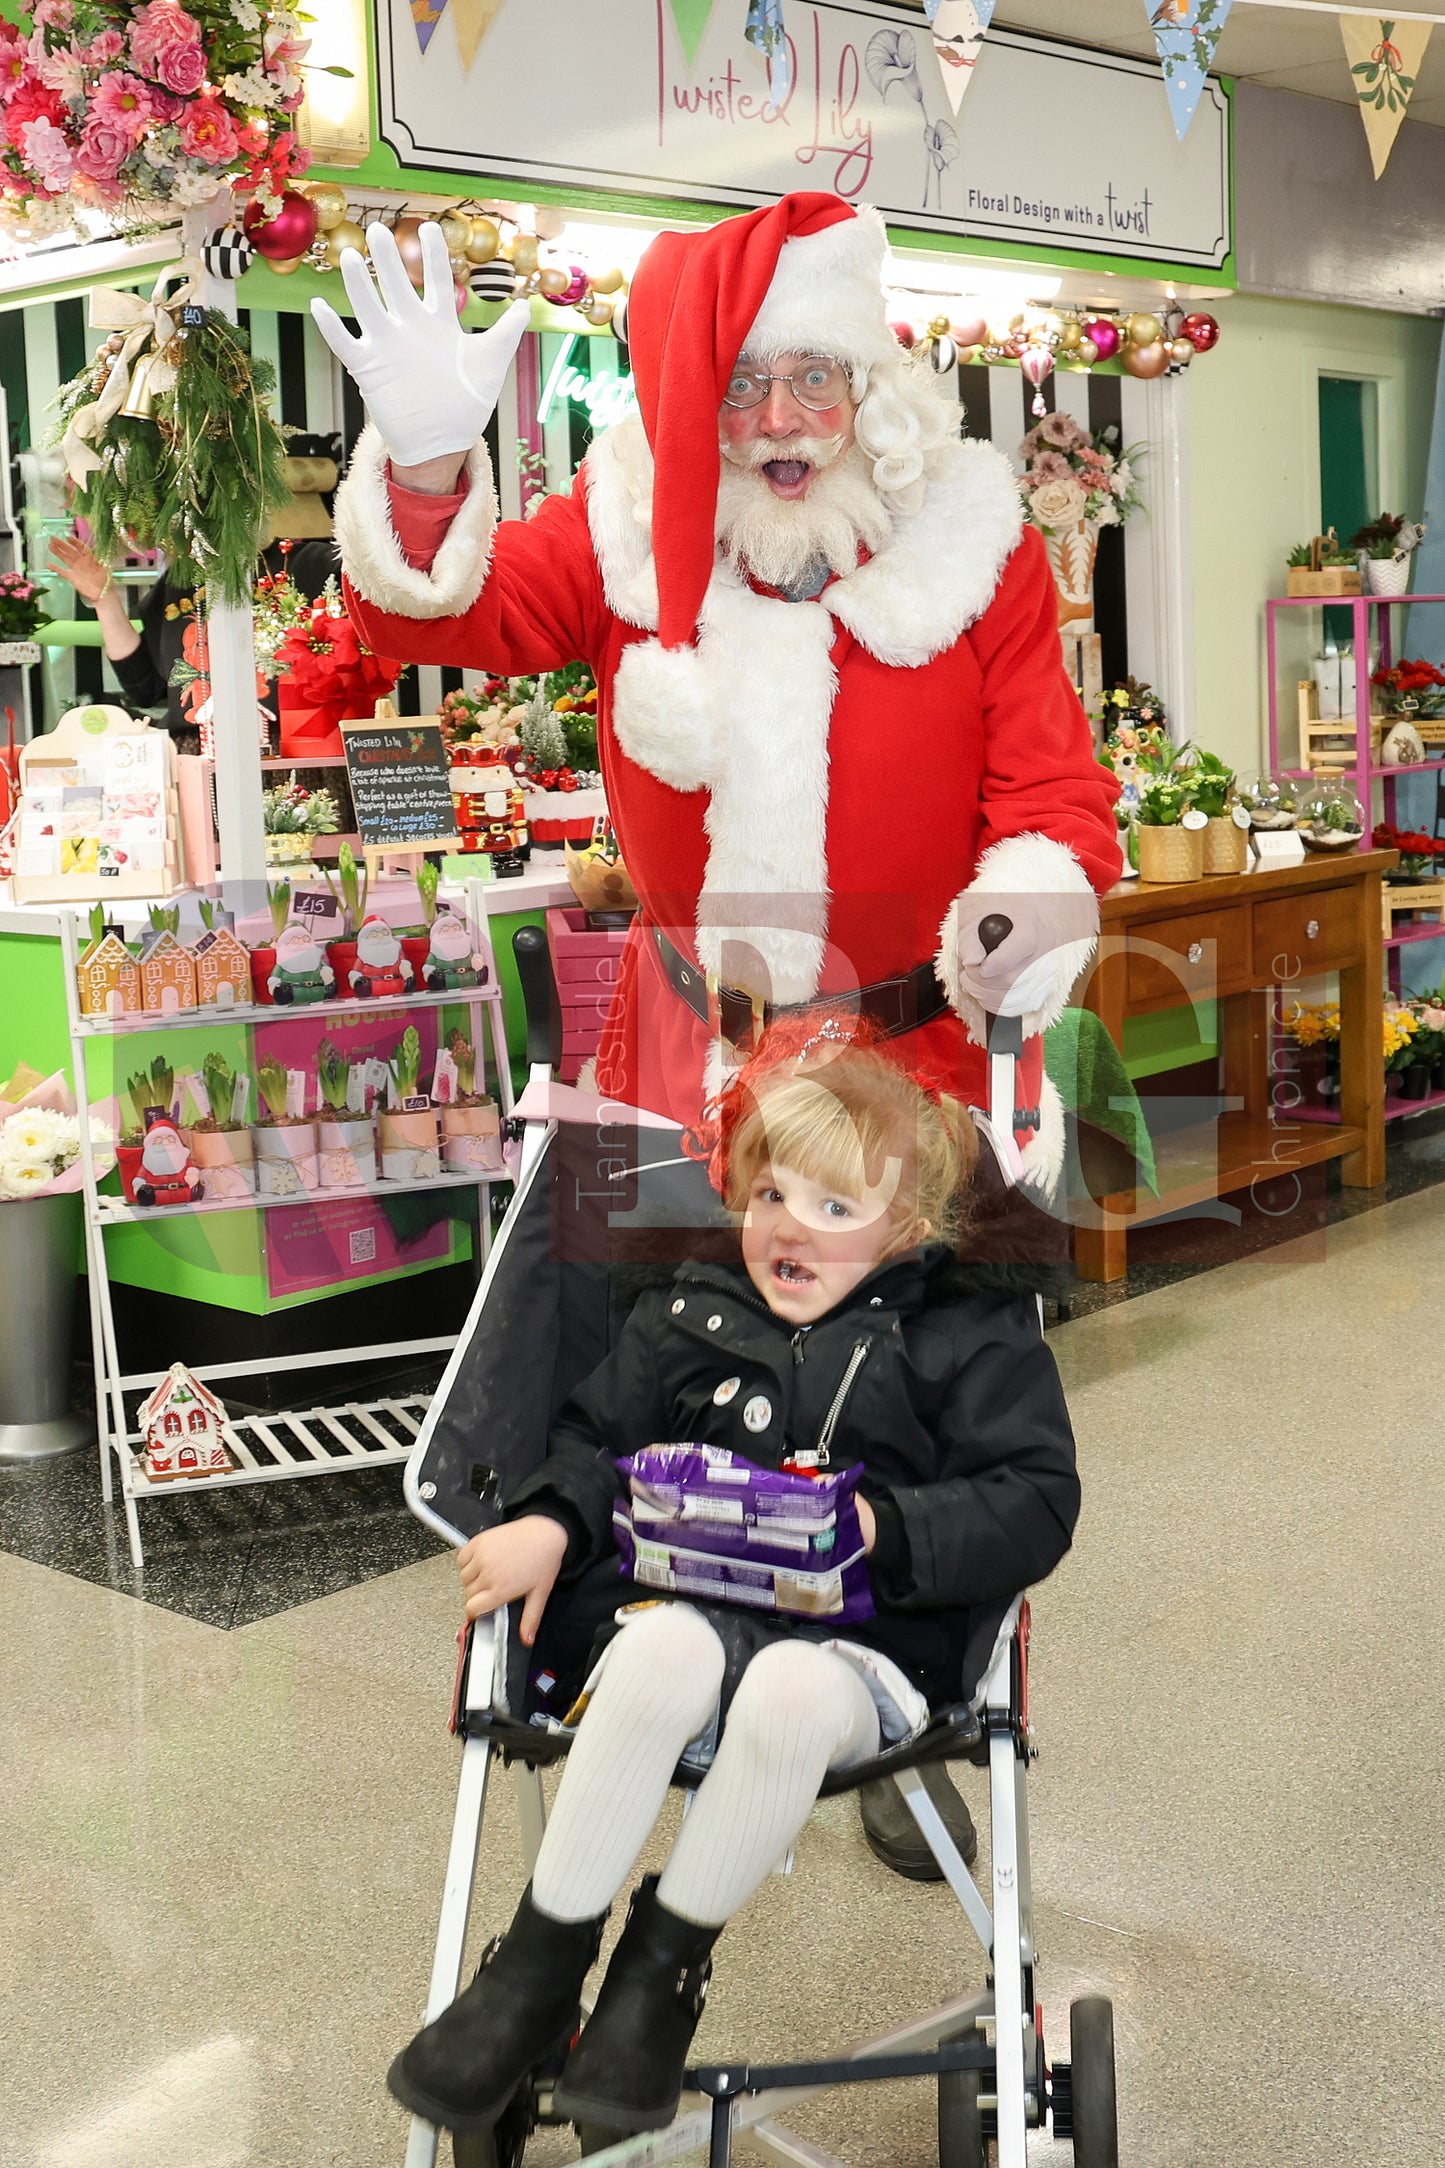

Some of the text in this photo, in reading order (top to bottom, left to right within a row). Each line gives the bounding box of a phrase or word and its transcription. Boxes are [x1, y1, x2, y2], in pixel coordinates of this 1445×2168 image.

[795, 10, 874, 197] Lily
[968, 181, 1153, 237] Floral Design with a twist
[345, 736, 381, 752] TWISTED
[350, 767, 379, 778] Because
[380, 766, 395, 775] who
[370, 776, 378, 784] of
[357, 789, 386, 801] Perfect
[387, 801, 407, 809] table
[358, 816, 380, 826] Small
[363, 833, 375, 845] £5
[296, 896, 326, 914] £15
[407, 1097, 425, 1108] £10
